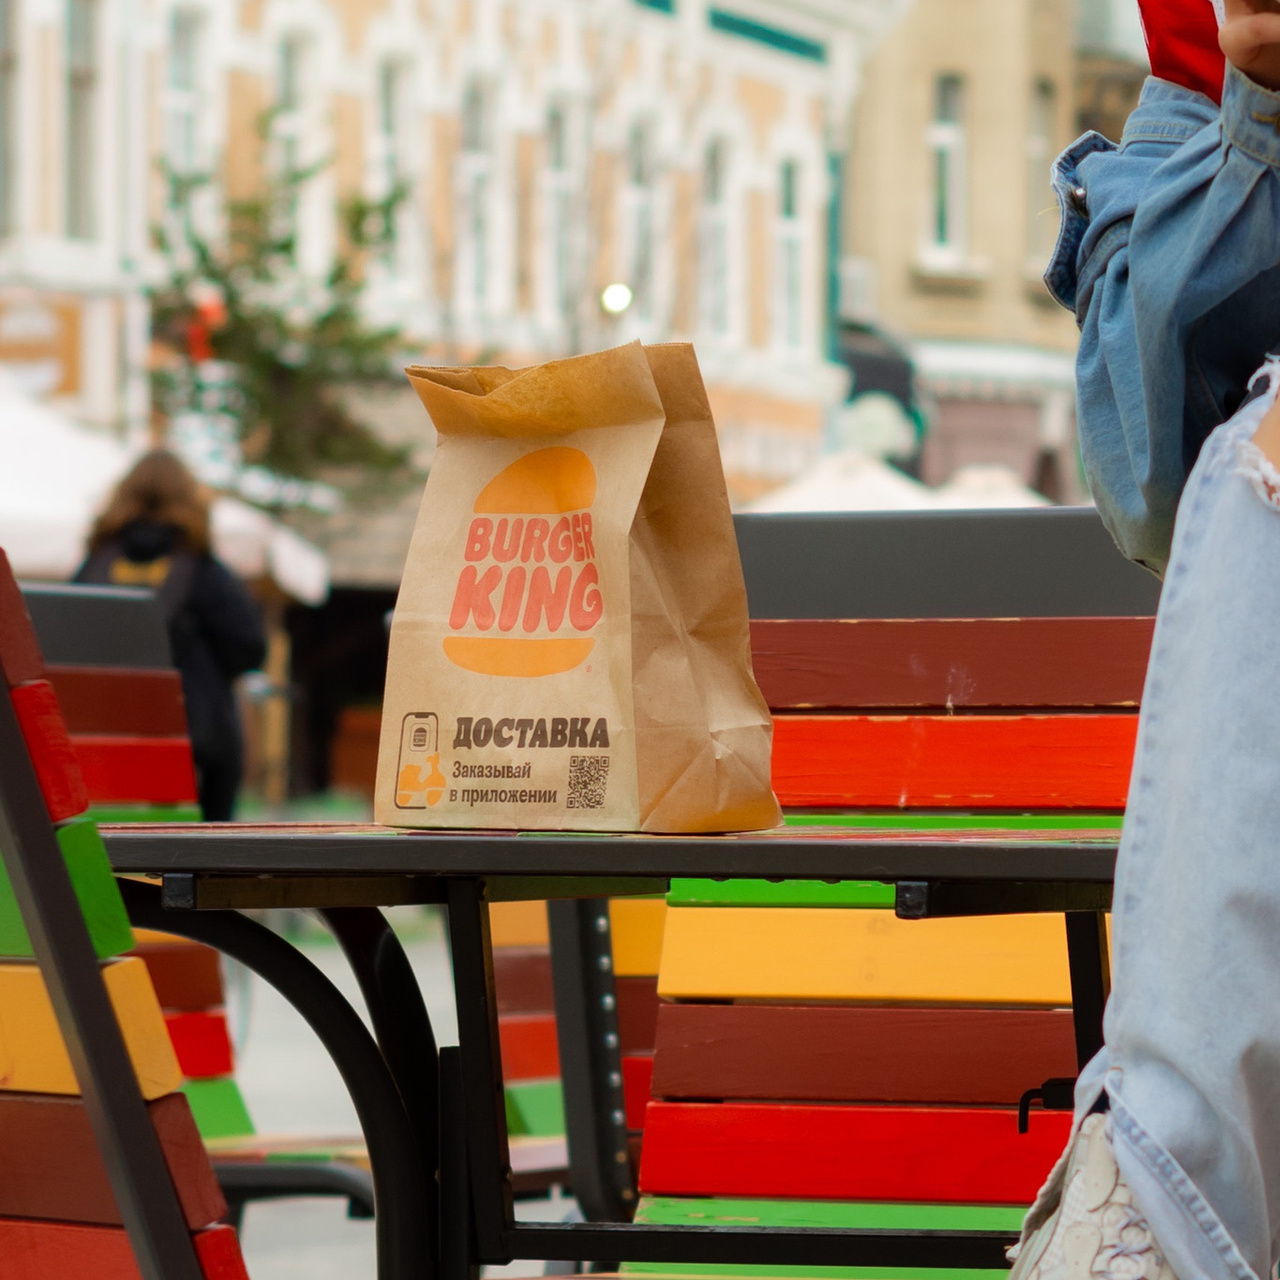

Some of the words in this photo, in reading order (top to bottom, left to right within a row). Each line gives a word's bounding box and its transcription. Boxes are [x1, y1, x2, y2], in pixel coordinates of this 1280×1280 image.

[464, 512, 596, 563] BURGER
[449, 563, 603, 632] KING
[452, 716, 610, 750] ДОСТАВКА
[452, 760, 532, 781] Заказывай
[449, 789, 458, 803] в
[461, 786, 557, 808] приложении
